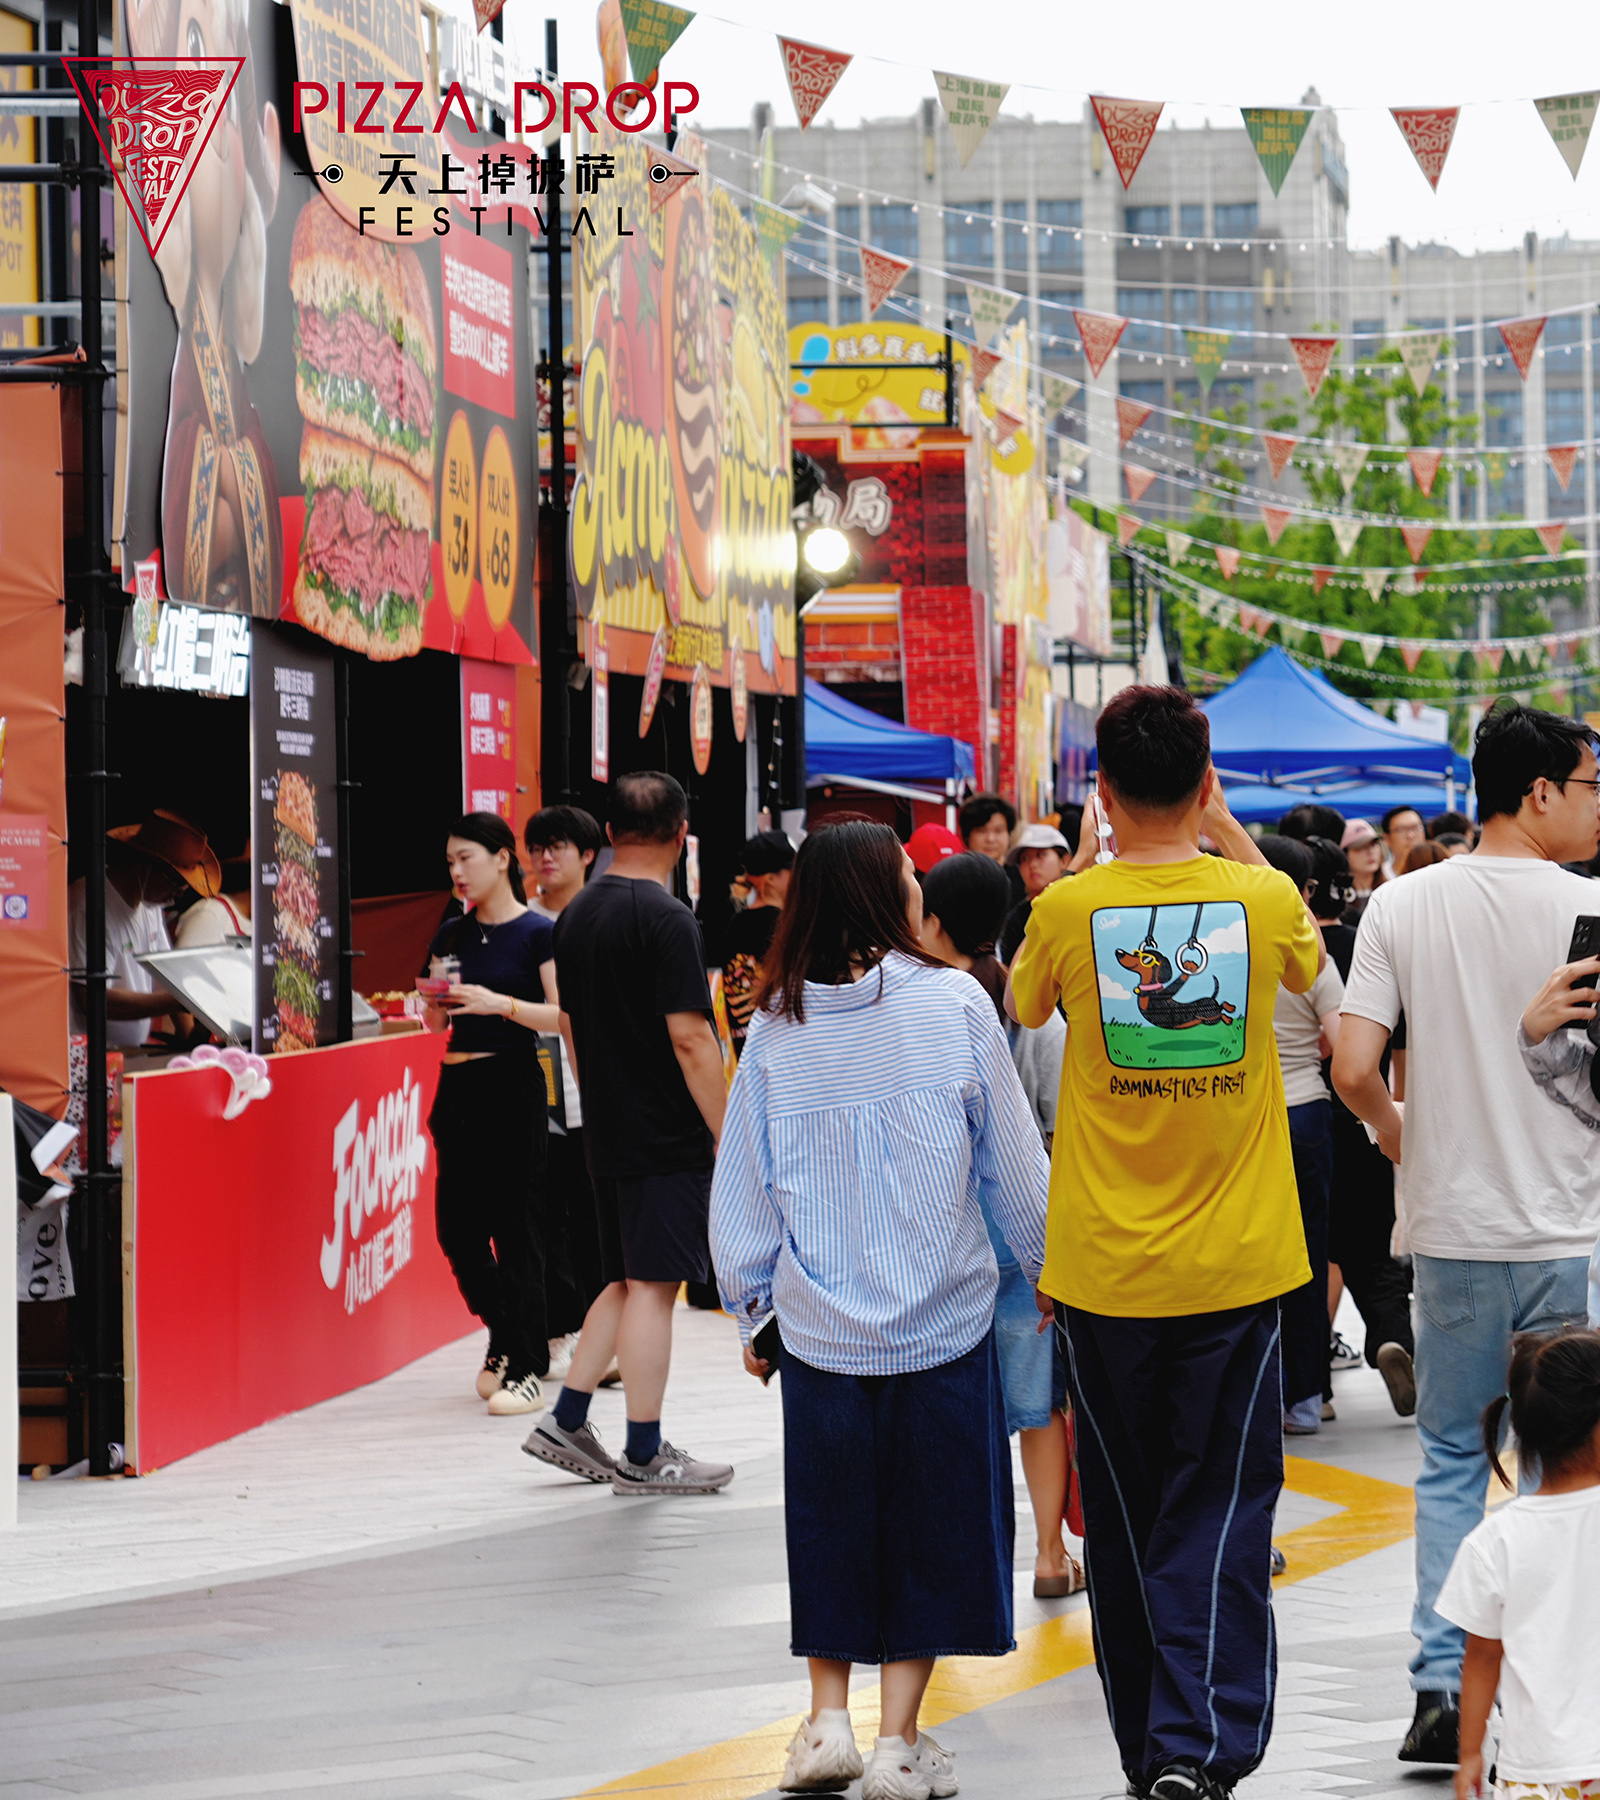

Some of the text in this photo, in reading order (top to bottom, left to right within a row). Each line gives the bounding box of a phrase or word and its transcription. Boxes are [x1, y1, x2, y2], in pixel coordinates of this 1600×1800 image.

[941, 76, 1002, 99] 上海首届
[956, 97, 985, 113] 国际
[948, 111, 990, 129] 披萨节
[1110, 1070, 1247, 1103] GYMNASTICS FIRST
